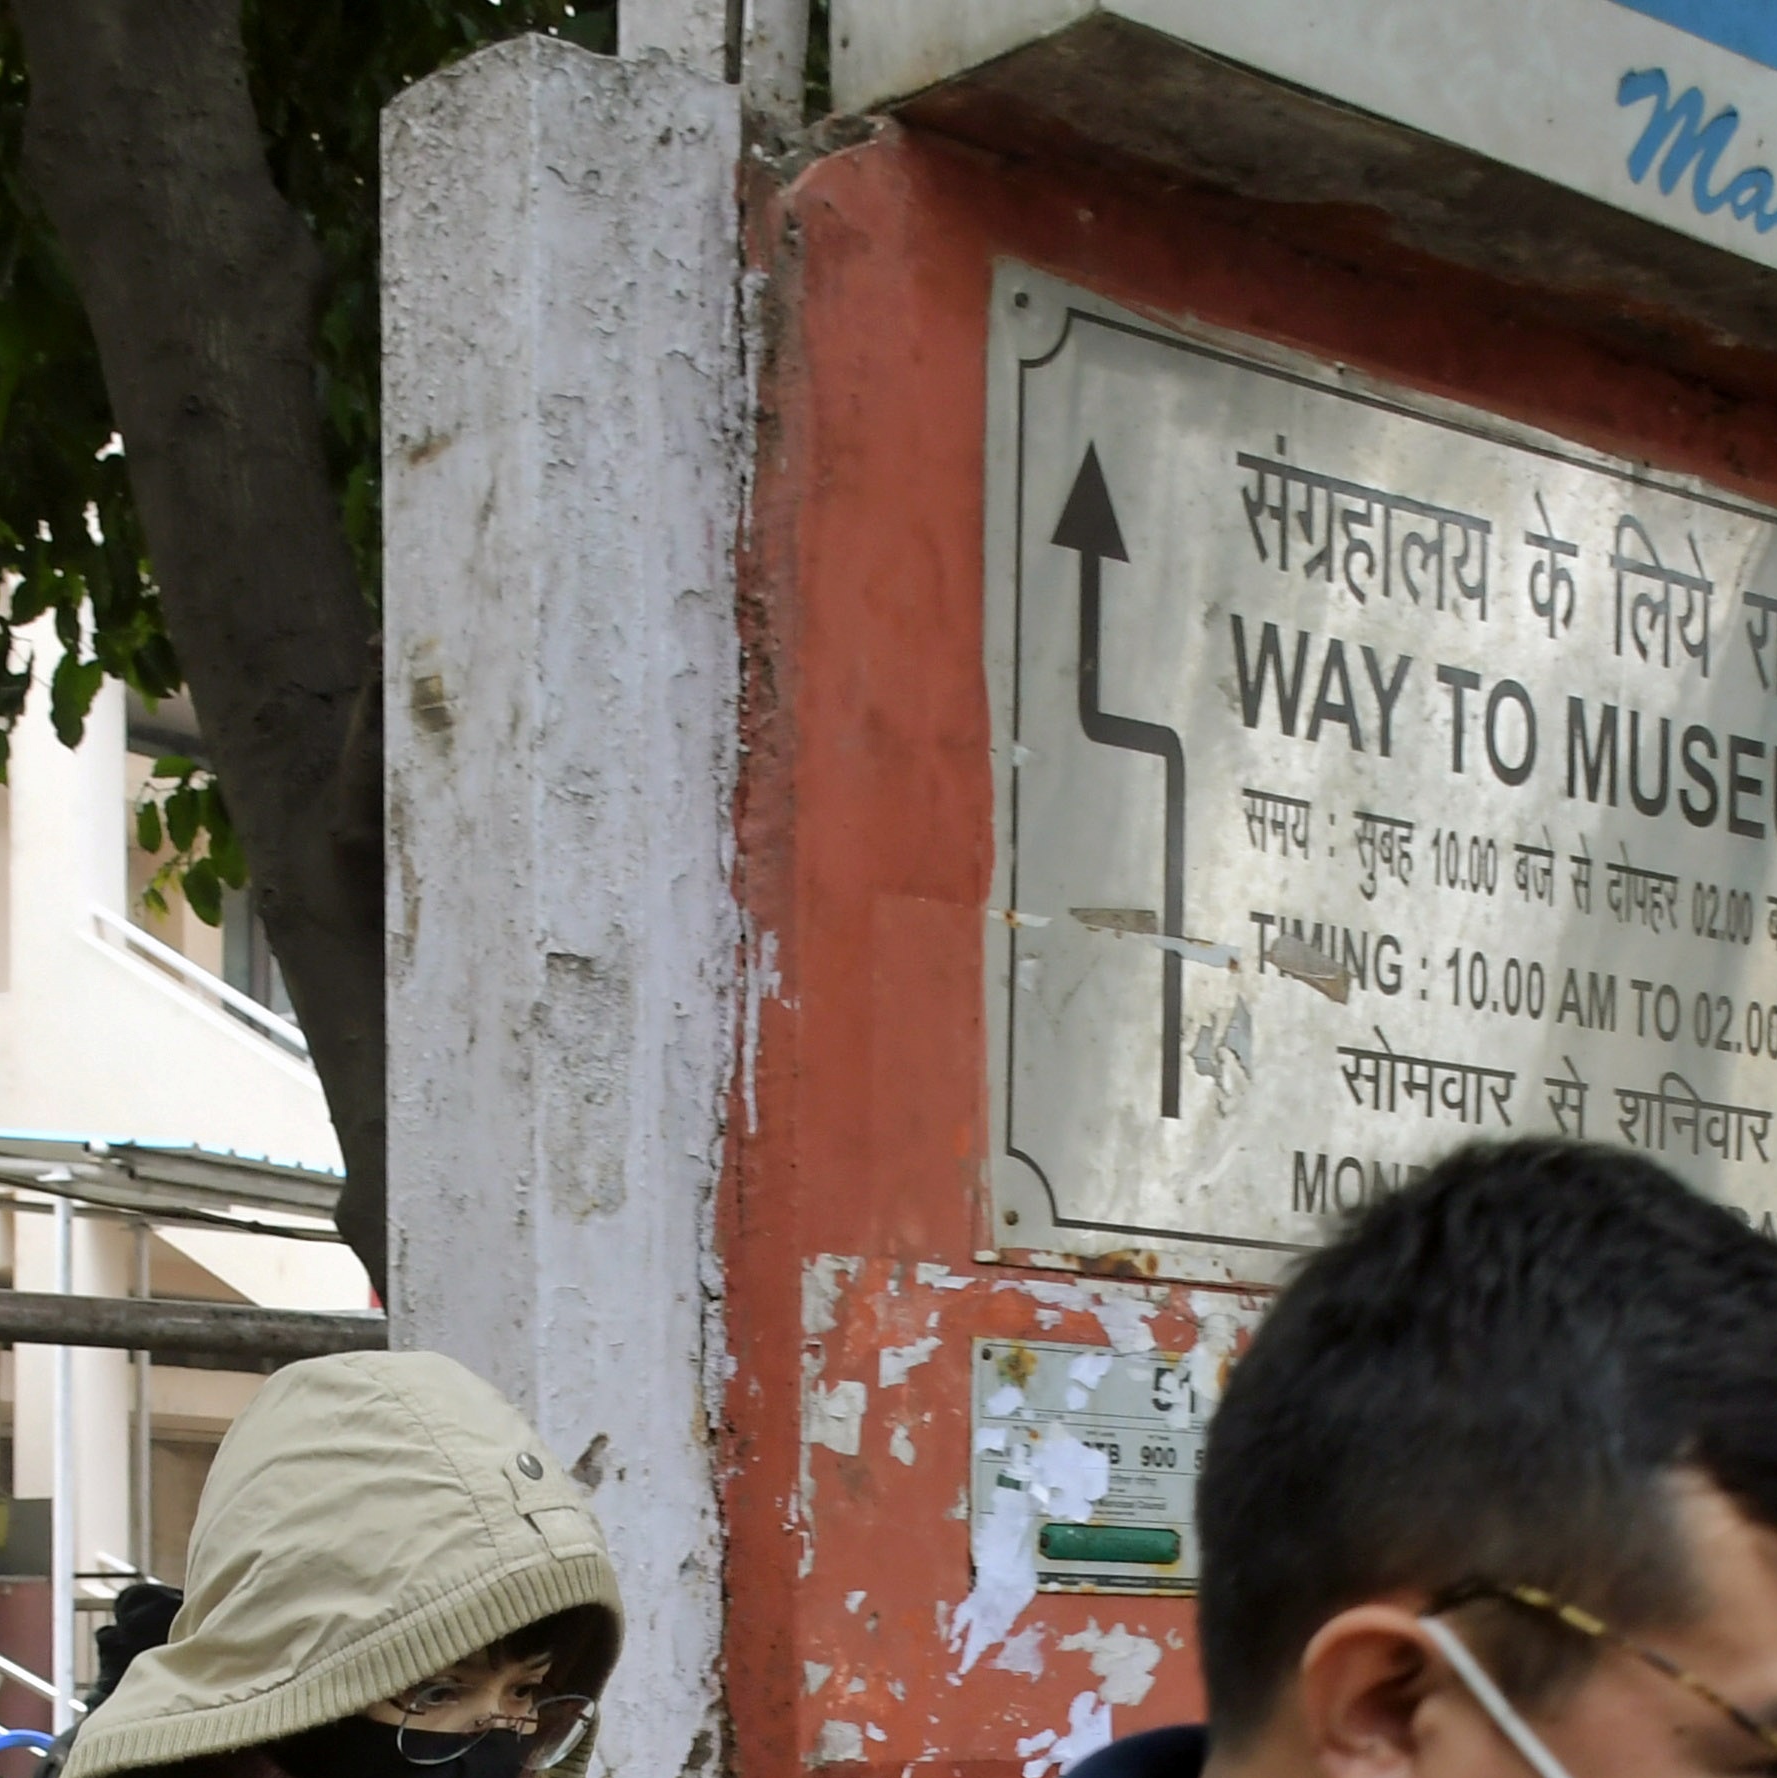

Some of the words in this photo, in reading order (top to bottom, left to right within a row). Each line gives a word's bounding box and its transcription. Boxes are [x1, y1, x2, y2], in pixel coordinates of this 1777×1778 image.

[1236, 435, 1492, 622] संग्रहालय
[1524, 490, 1579, 639] के
[1609, 513, 1714, 679] लिये
[1230, 613, 1413, 758] WAY
[1436, 663, 1538, 787] TO
[1243, 788, 1311, 860] समय
[1353, 810, 1415, 901] सुबह
[1430, 827, 1498, 897] 10.00
[1513, 825, 1555, 906] बजे
[1570, 833, 1592, 915] से
[1605, 841, 1679, 935] दोपहर
[1690, 881, 1754, 946] 02.00
[1446, 947, 1545, 1020] 10.00
[1557, 967, 1616, 1033] AM
[1630, 978, 1681, 1043] TO
[1337, 1025, 1516, 1127] सोमवार
[1544, 1055, 1589, 1139] से
[1614, 1071, 1774, 1163] शनिवार
[1140, 1446, 1177, 1468] 900
